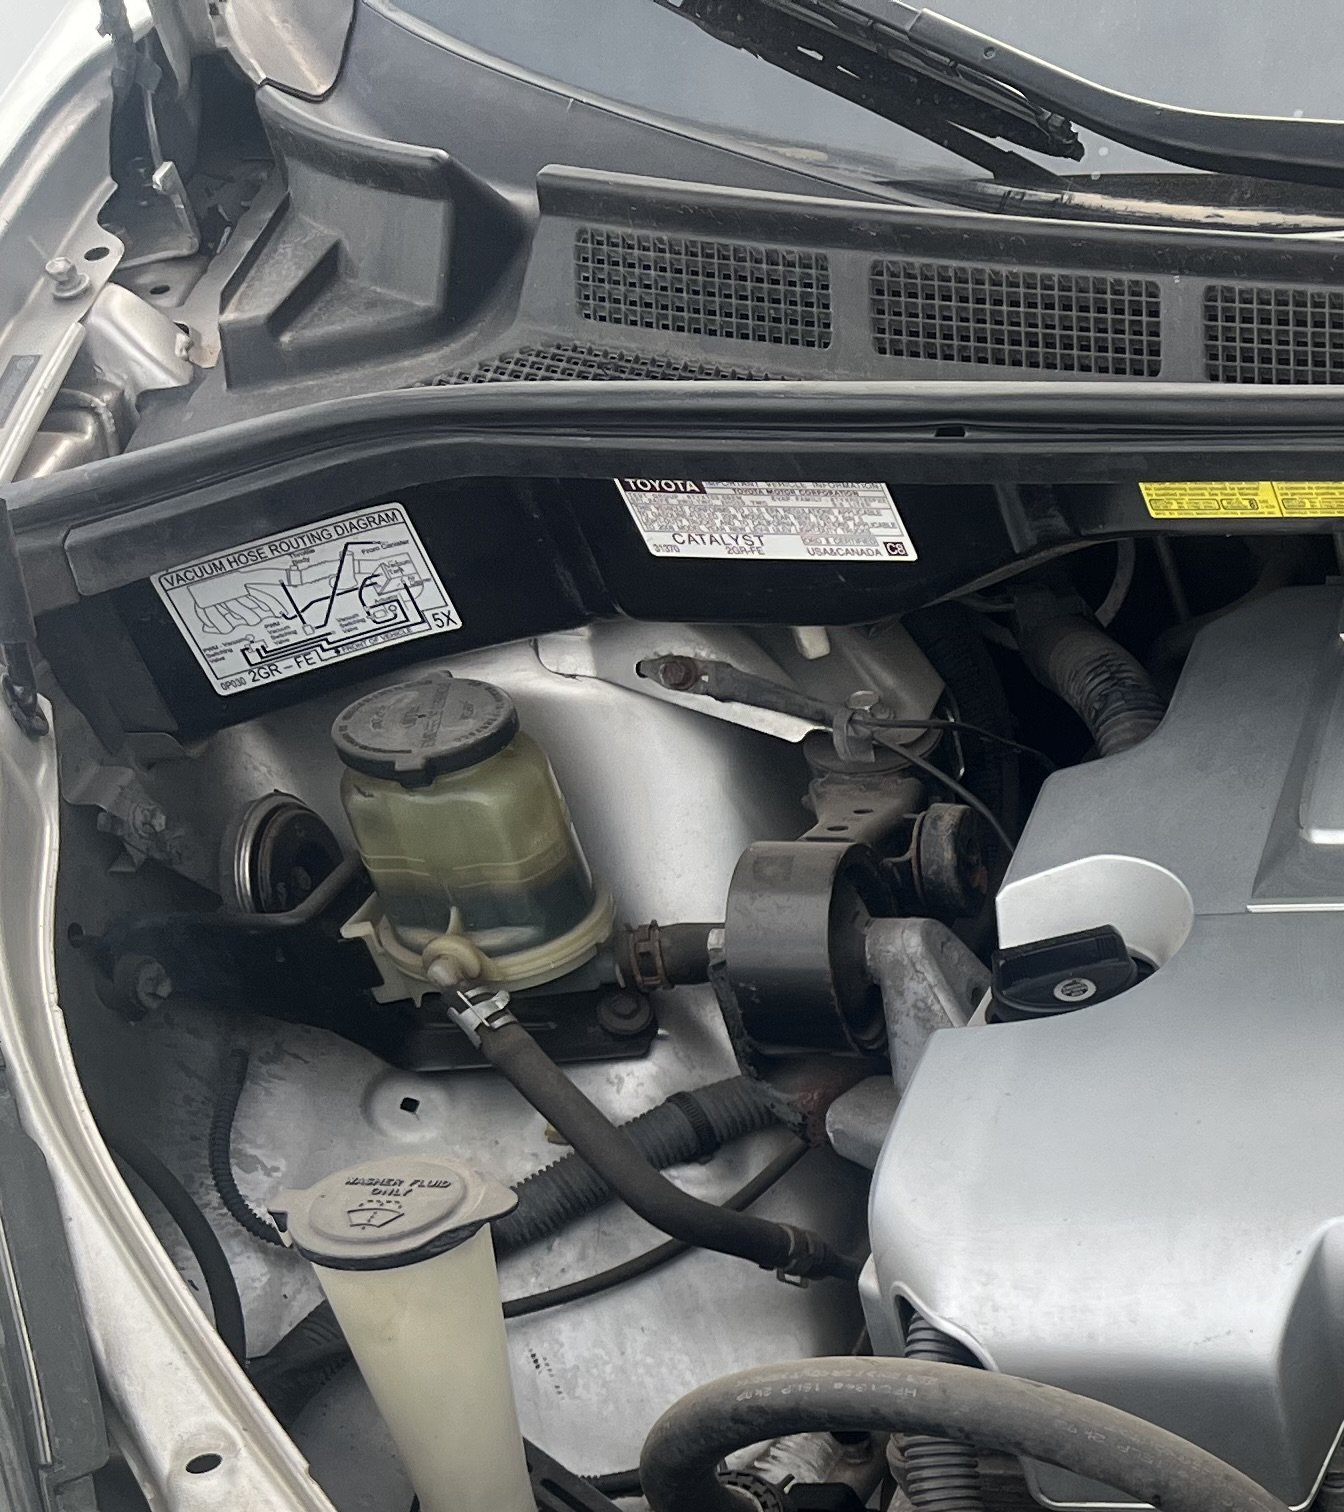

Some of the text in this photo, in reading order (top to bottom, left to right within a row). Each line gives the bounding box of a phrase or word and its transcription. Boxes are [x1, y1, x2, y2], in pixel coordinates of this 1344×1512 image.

[625, 478, 701, 493] TOYOTA
[672, 533, 765, 547] CATALYST
[164, 510, 400, 587] VACUUM HOSE ROUTING DIAGRAM
[653, 544, 680, 553] 31370
[807, 547, 884, 557] USA&CANADA
[431, 611, 458, 629] 5X
[345, 1176, 452, 1189] WASHER FLUID
[370, 1187, 413, 1197] ONLY
